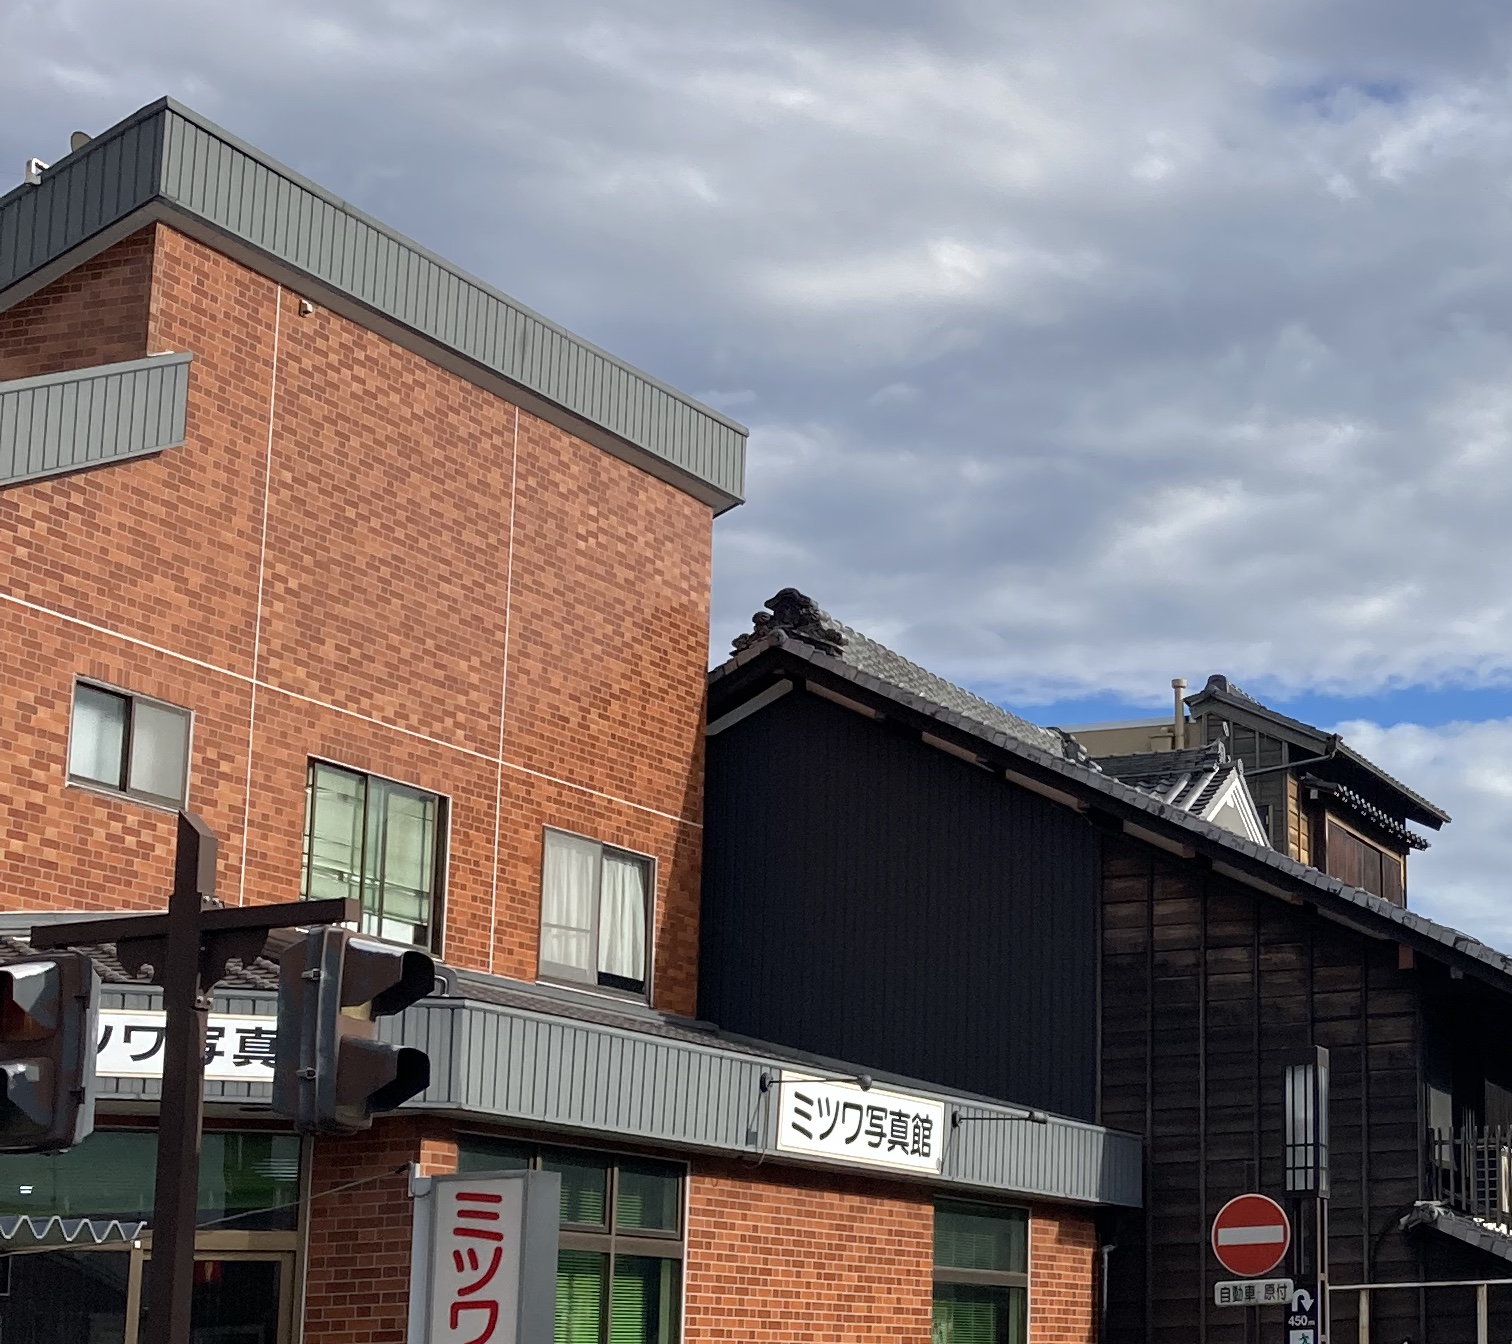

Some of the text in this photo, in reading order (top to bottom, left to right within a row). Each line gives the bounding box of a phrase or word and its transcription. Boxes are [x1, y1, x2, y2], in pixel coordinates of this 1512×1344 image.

[791, 1090, 934, 1158] ミツワ写真館
